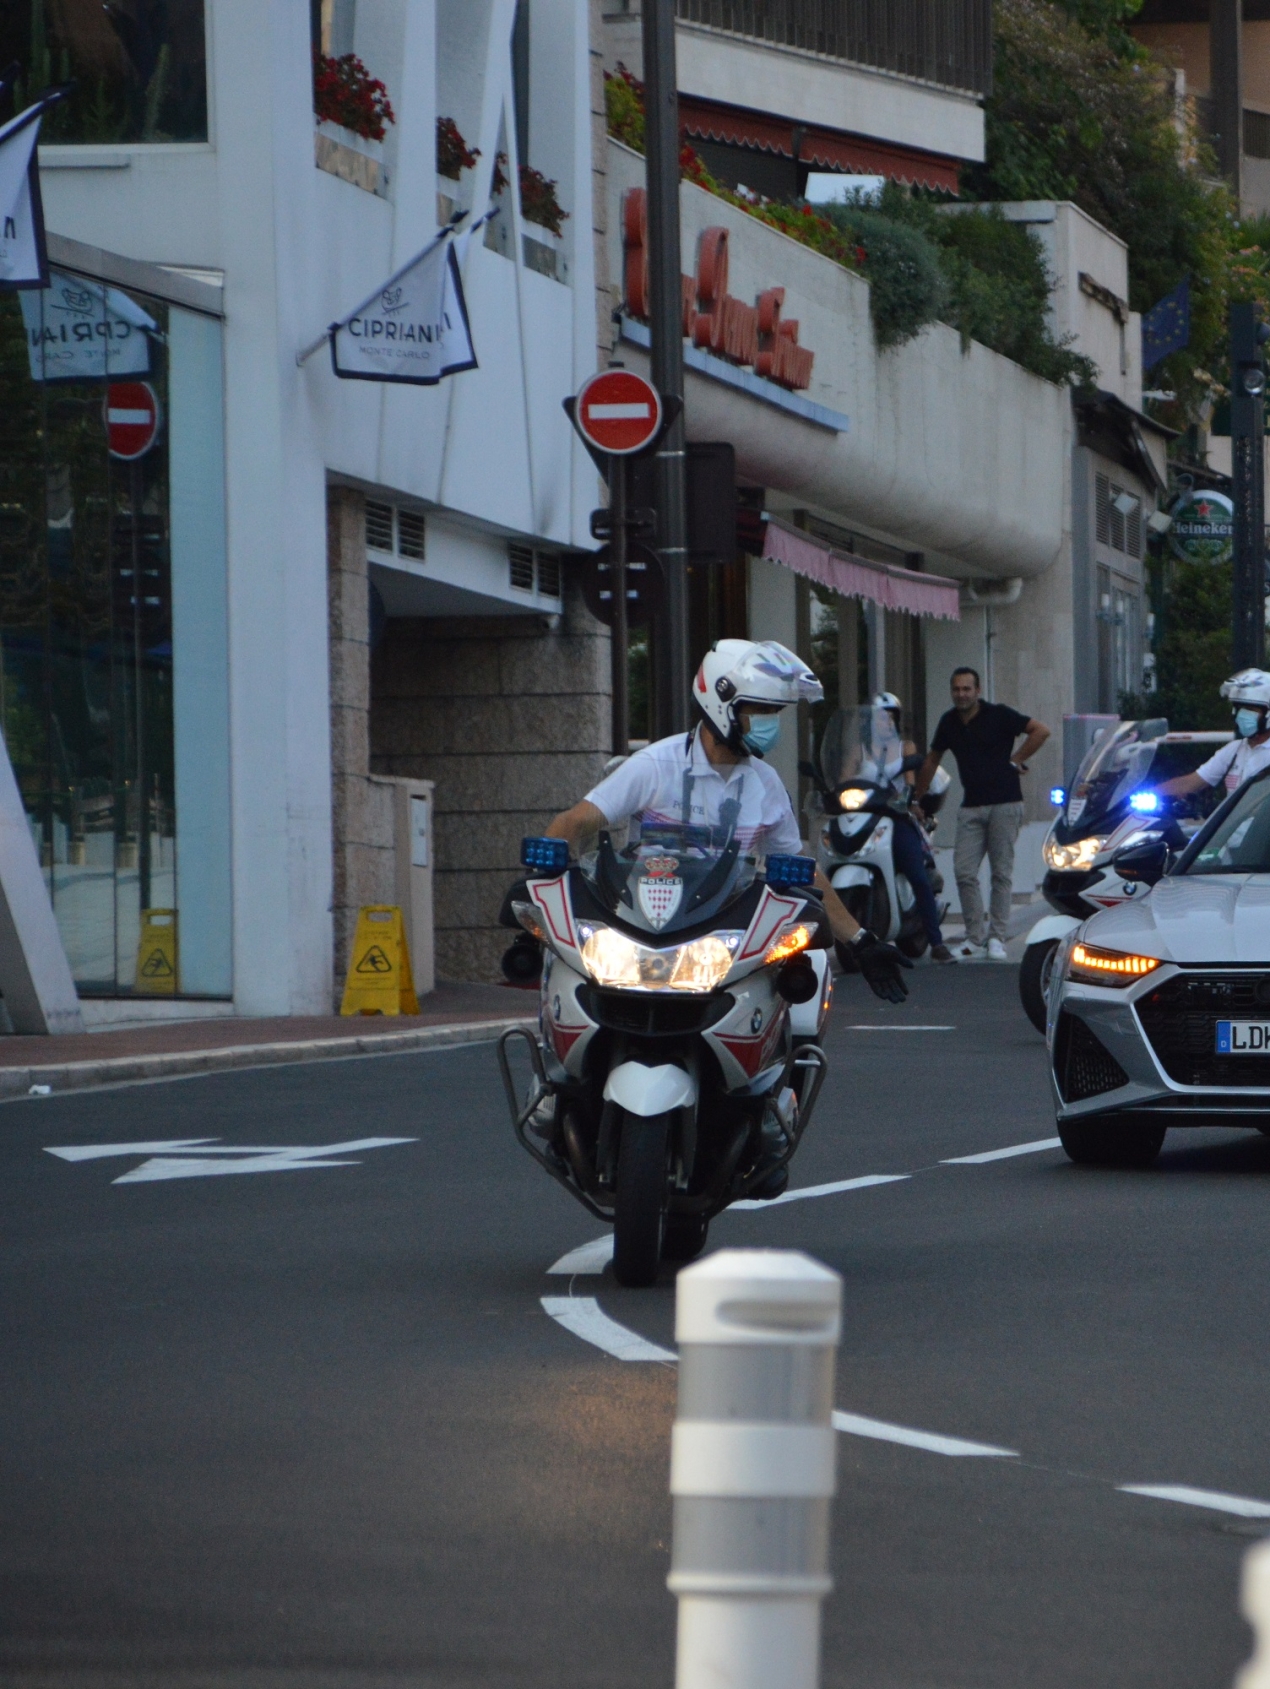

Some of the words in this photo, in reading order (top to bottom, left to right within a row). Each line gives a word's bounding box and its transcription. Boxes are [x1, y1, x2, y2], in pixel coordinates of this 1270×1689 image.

[348, 318, 441, 343] CIPRIANI
[359, 345, 392, 357] MONTE
[396, 349, 430, 359] CARLO
[640, 877, 680, 885] POLICE
